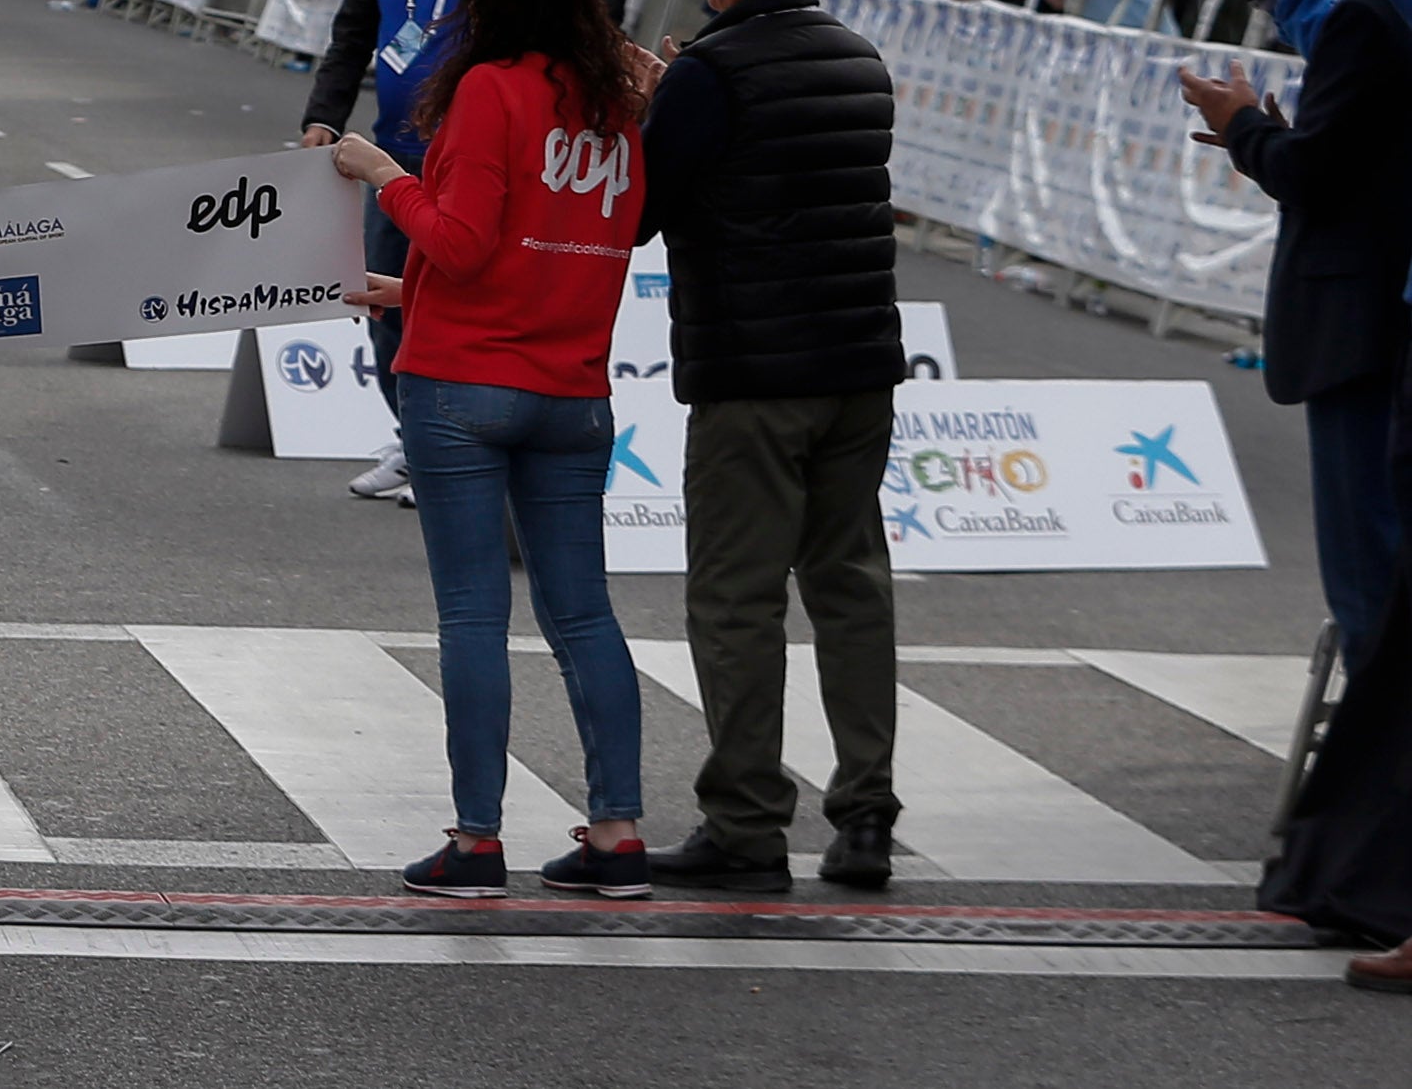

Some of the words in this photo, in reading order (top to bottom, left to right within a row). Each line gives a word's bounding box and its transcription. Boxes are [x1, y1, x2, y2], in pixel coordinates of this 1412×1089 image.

[187, 176, 282, 239] edp
[930, 406, 1037, 440] MARATÓN
[935, 505, 1068, 532] CaixaBank
[1112, 499, 1230, 523] CaixaBank
